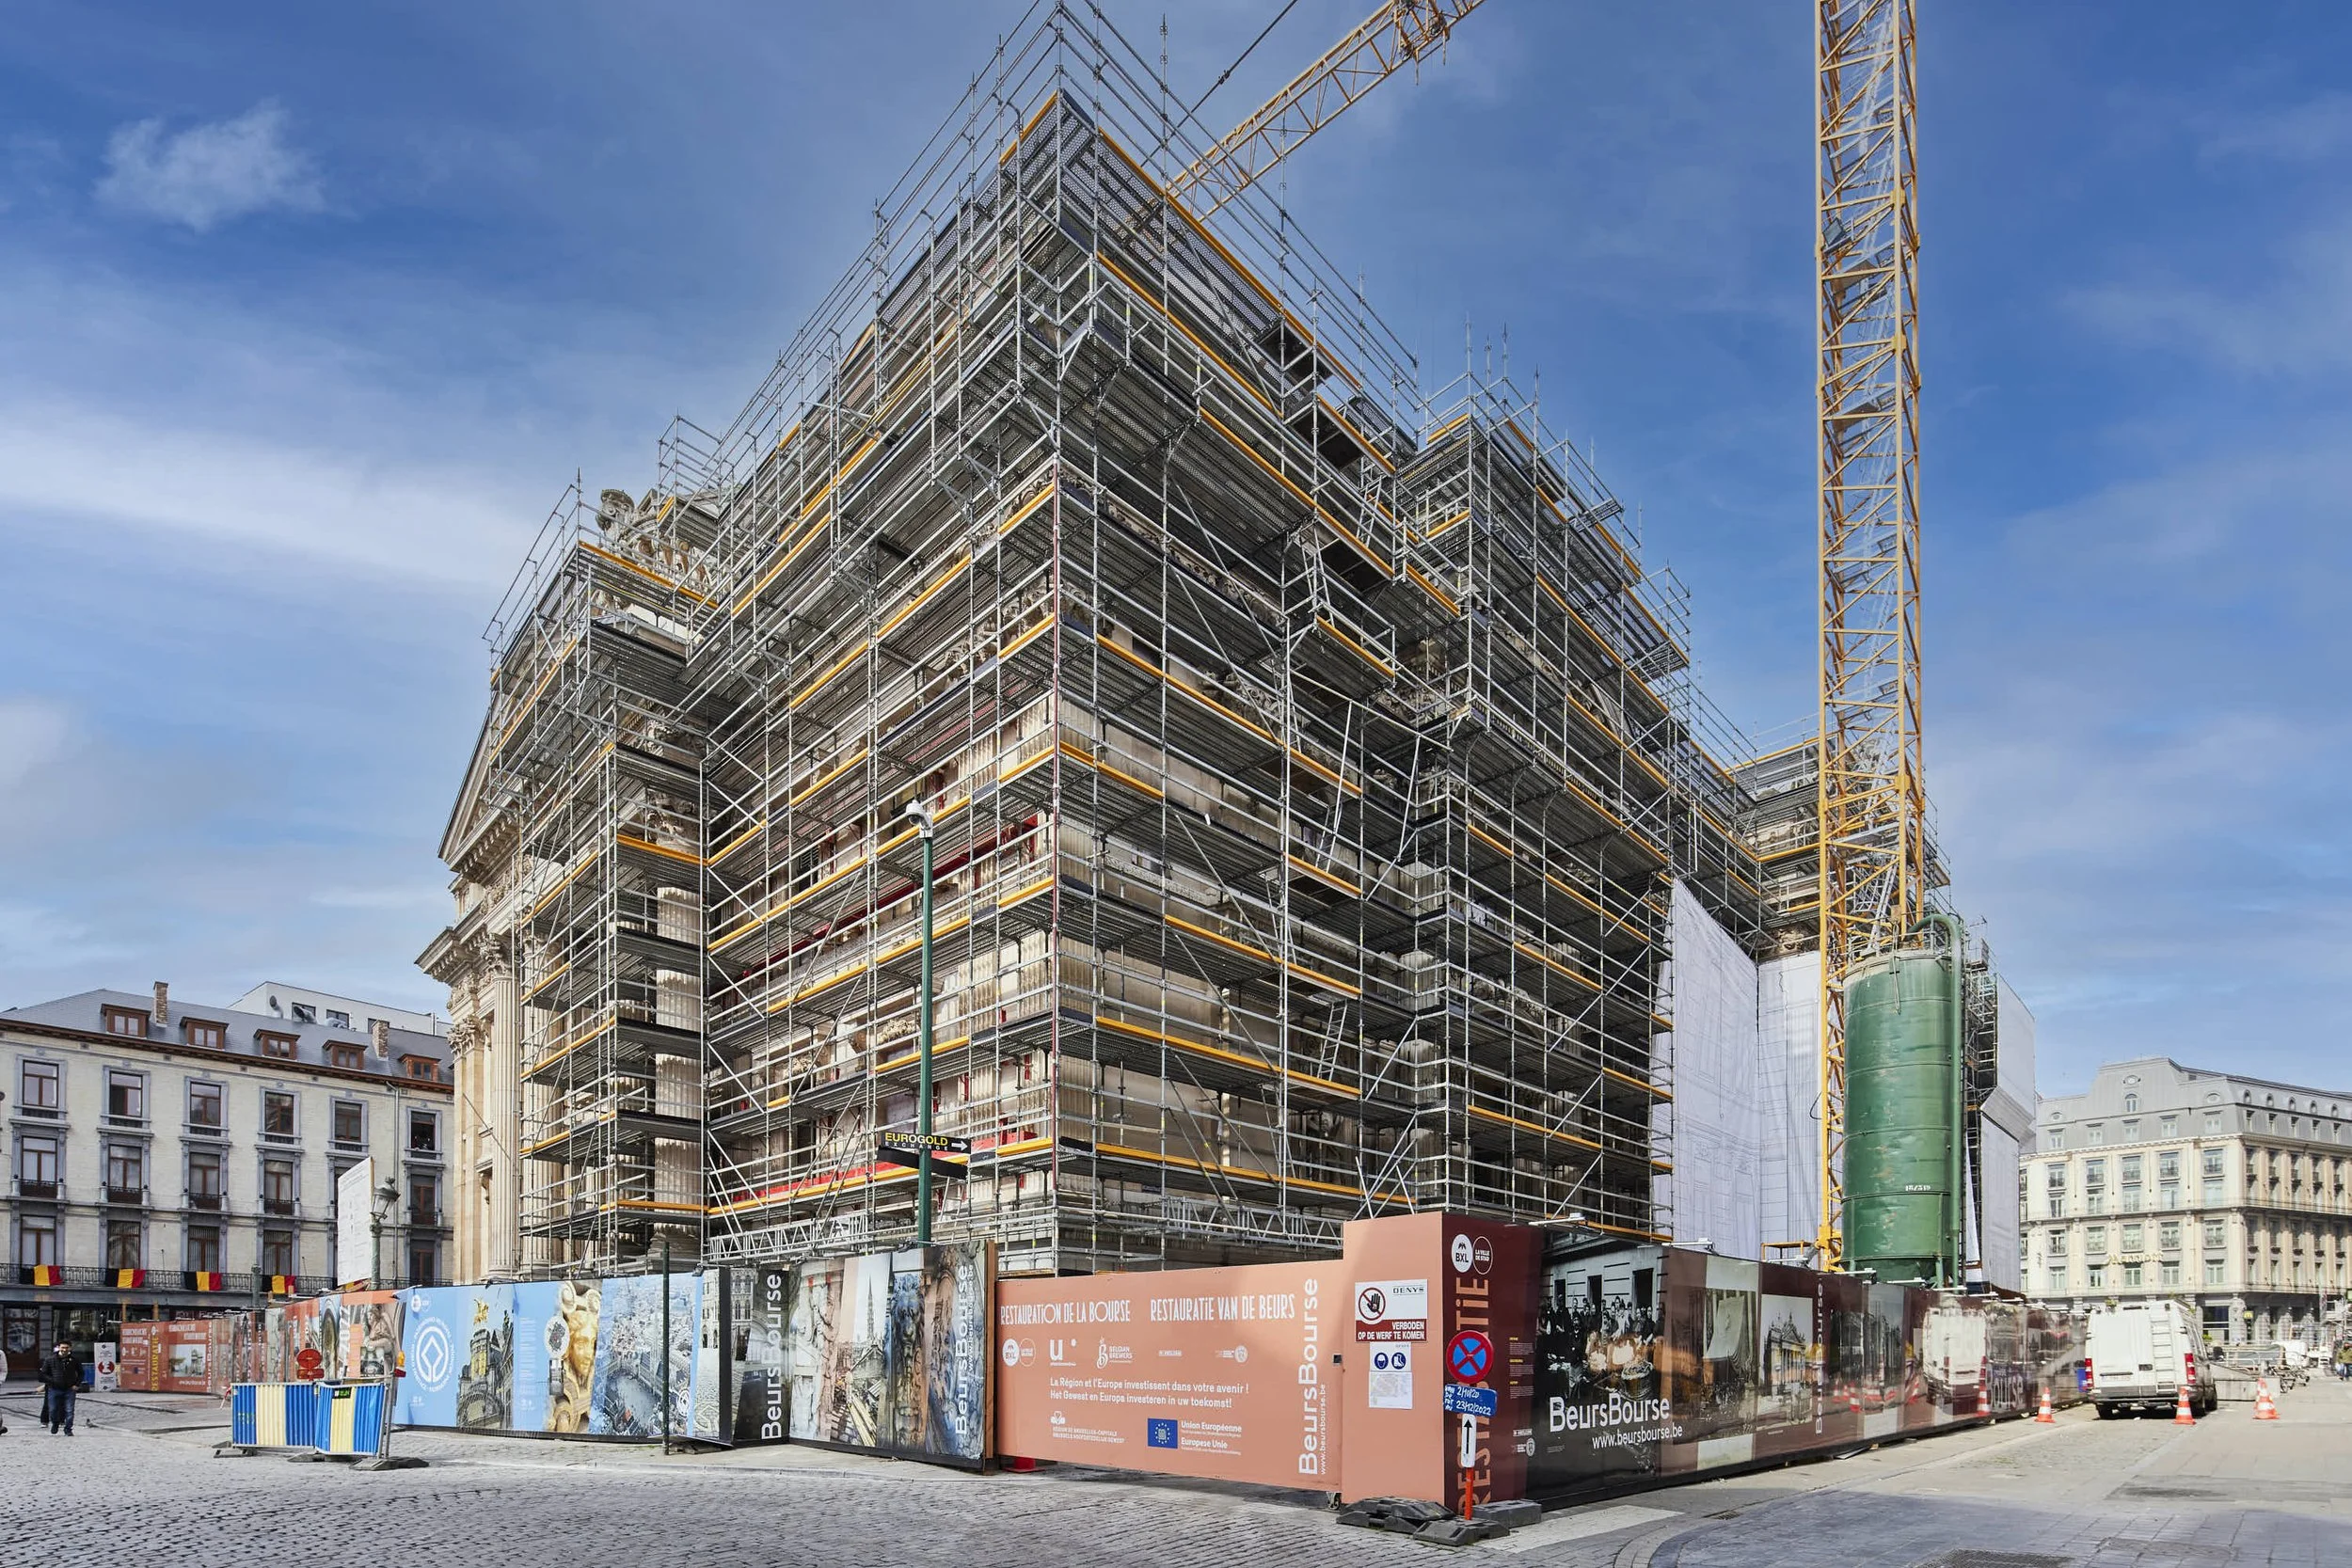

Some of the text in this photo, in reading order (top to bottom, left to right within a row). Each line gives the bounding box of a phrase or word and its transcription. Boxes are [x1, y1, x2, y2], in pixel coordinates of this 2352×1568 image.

[885, 1132, 948, 1146] EUROGOLD
[885, 1141, 948, 1151] EXCHANGE
[1455, 1252, 1469, 1262] BXL
[1393, 1286, 1424, 1294] DENYS
[1064, 1302, 1074, 1323] DE
[1076, 1302, 1087, 1323] LA
[1089, 1300, 1131, 1322] BOURSE
[1217, 1296, 1238, 1321] VAN
[1242, 1295, 1255, 1320] DE
[1259, 1293, 1295, 1320] BEURS
[1392, 1321, 1424, 1330] VERBODEN
[1358, 1330, 1425, 1339] OP DE WERF TE KOMEN
[761, 1274, 782, 1440] BeursBourse
[956, 1265, 968, 1434] BeursBourse
[1298, 1278, 1318, 1475] BeursBourse
[1050, 1377, 1058, 1386] La
[1059, 1377, 1084, 1388] Région
[1085, 1379, 1092, 1387] et
[1093, 1378, 1122, 1389] l'Europe
[1124, 1379, 1170, 1391] investissent
[1172, 1381, 1191, 1392] dans
[1193, 1383, 1215, 1393] votre
[1216, 1384, 1244, 1394] avenir
[1050, 1389, 1062, 1400] Het
[1063, 1390, 1088, 1401] Gewest
[1100, 1392, 1125, 1403] Europa
[1126, 1393, 1167, 1404] investeren
[1168, 1395, 1176, 1405] in
[1178, 1397, 1189, 1406] uw
[1191, 1396, 1232, 1408] toekomst!
[1549, 1392, 1670, 1433] BeursBourse
[1181, 1420, 1242, 1433] Union Européenne
[1592, 1421, 1683, 1449] www.beursbourse.be
[1181, 1437, 1228, 1449] Europese Unie
